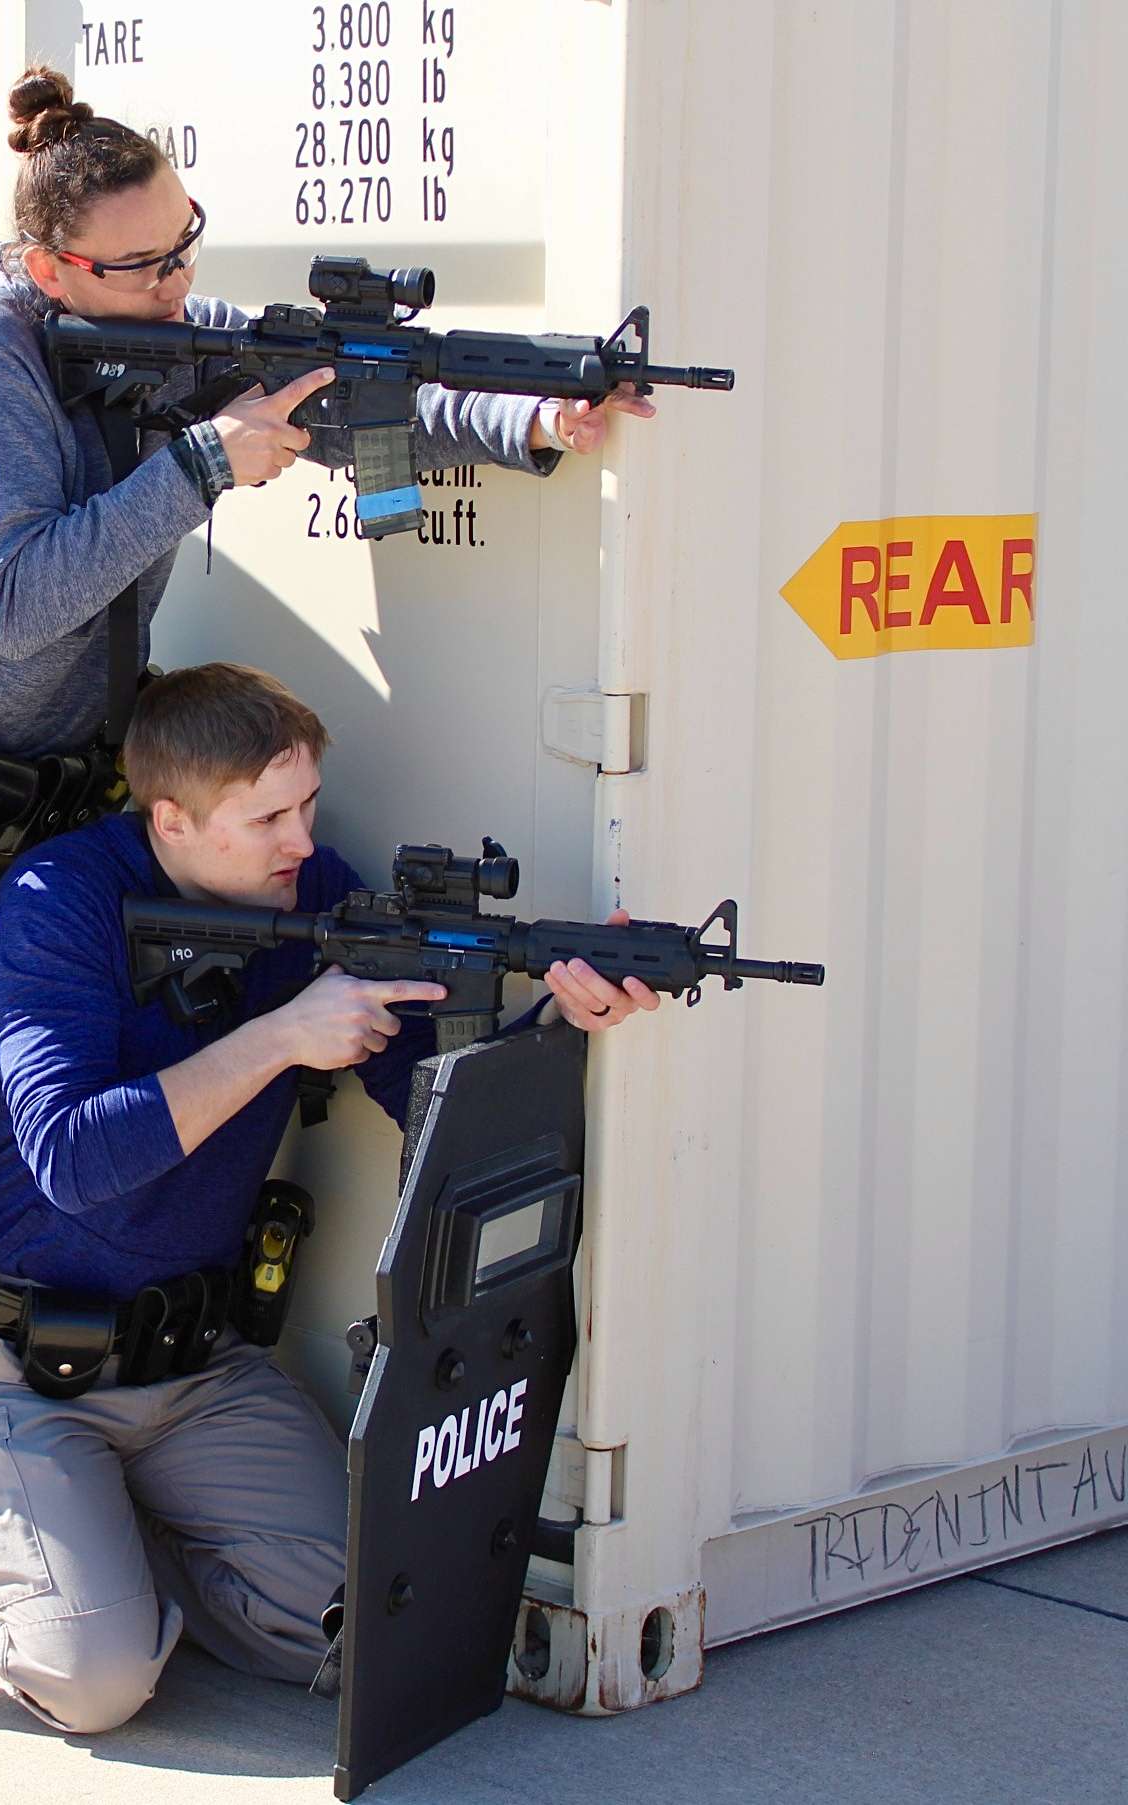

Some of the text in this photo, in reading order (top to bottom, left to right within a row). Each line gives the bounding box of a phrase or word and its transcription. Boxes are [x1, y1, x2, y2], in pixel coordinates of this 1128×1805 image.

[83, 19, 144, 67] TARE
[312, 0, 454, 57] 3,800 kg
[312, 57, 446, 110] 8,380 lb
[295, 117, 454, 176] 28,700 kg
[295, 175, 447, 226] 63,270 lb
[307, 493, 385, 541] 2,6
[839, 538, 1035, 635] REAR
[171, 948, 193, 962] 190
[411, 1378, 528, 1502] POLICE
